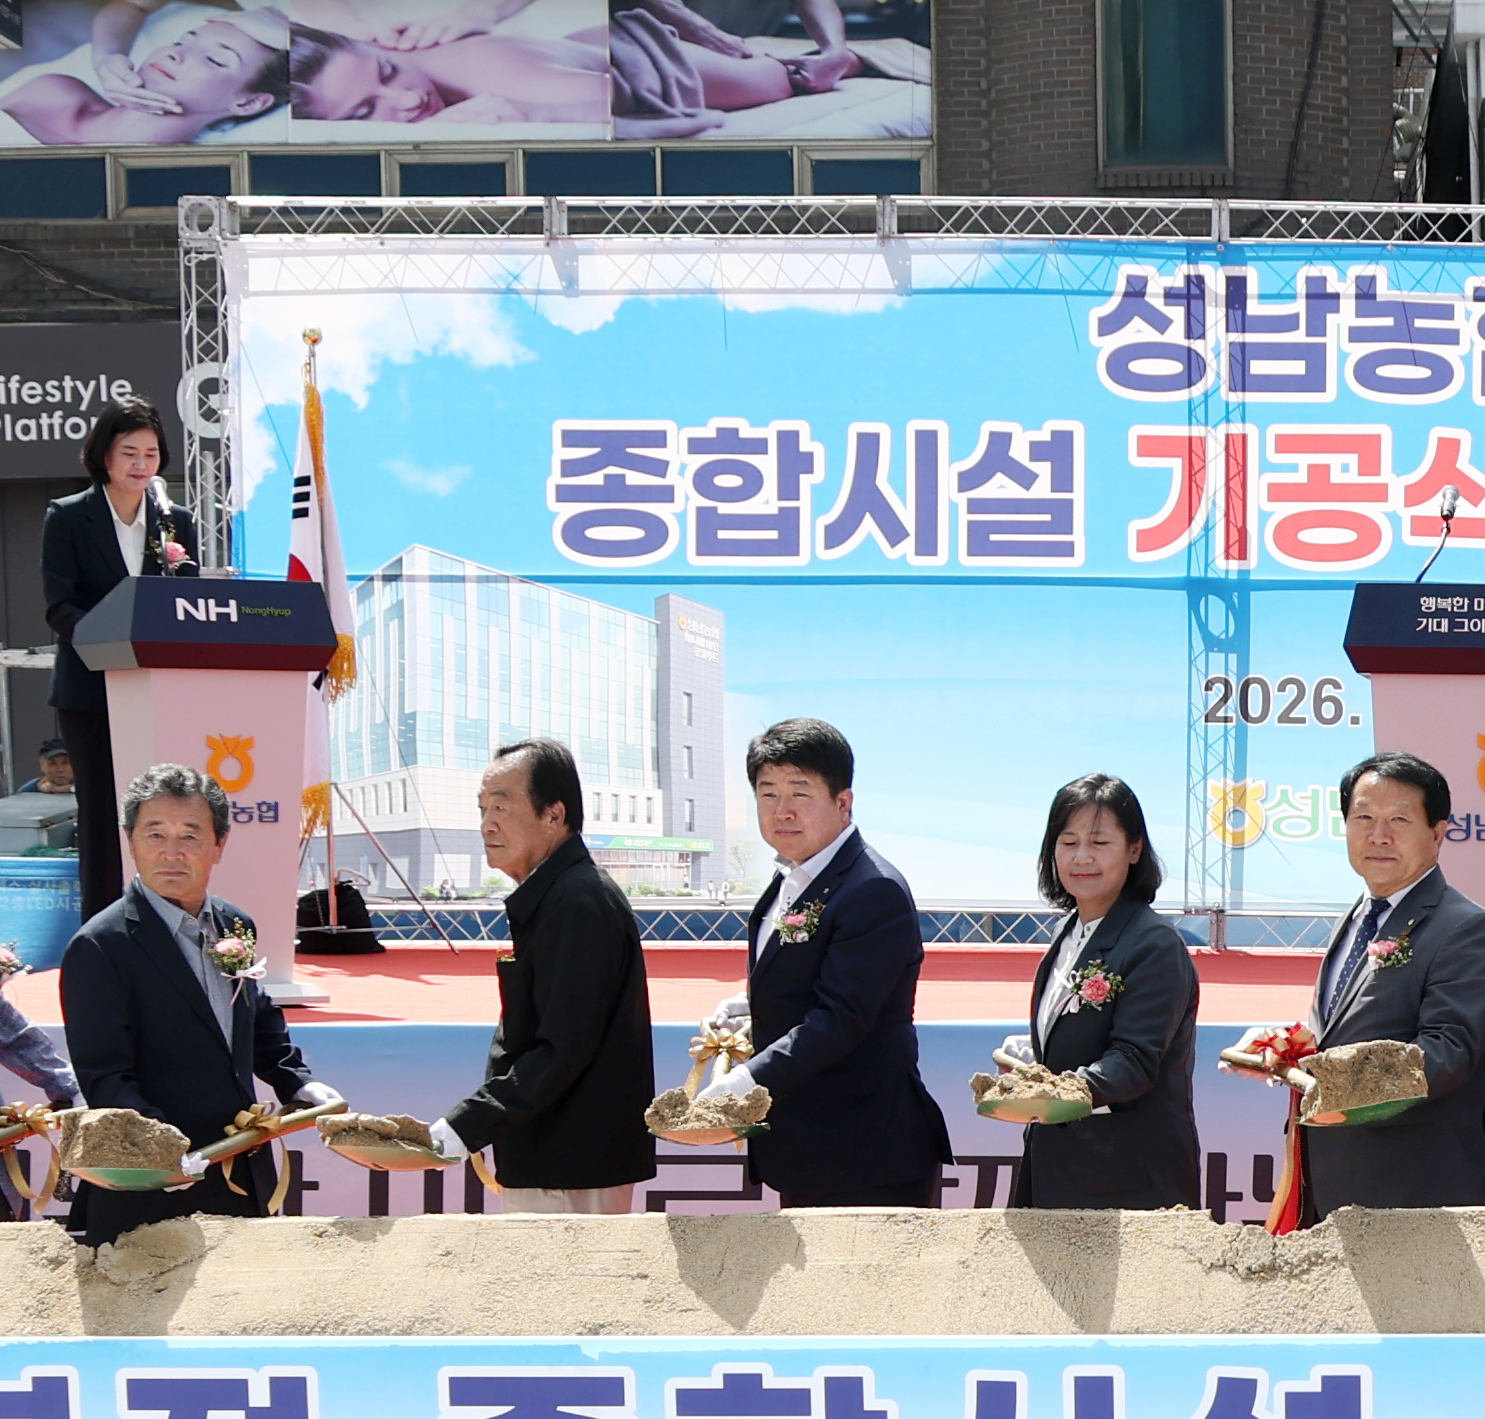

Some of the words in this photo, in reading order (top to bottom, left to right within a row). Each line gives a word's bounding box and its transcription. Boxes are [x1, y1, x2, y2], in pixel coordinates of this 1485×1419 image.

[552, 423, 1077, 561] 종합시설
[175, 597, 239, 622] NH
[241, 605, 292, 617] NongHyup
[1419, 596, 1470, 613] 행복한
[1415, 617, 1449, 633] 기대
[1202, 675, 1361, 727] 2026.
[231, 800, 279, 823] 농협
